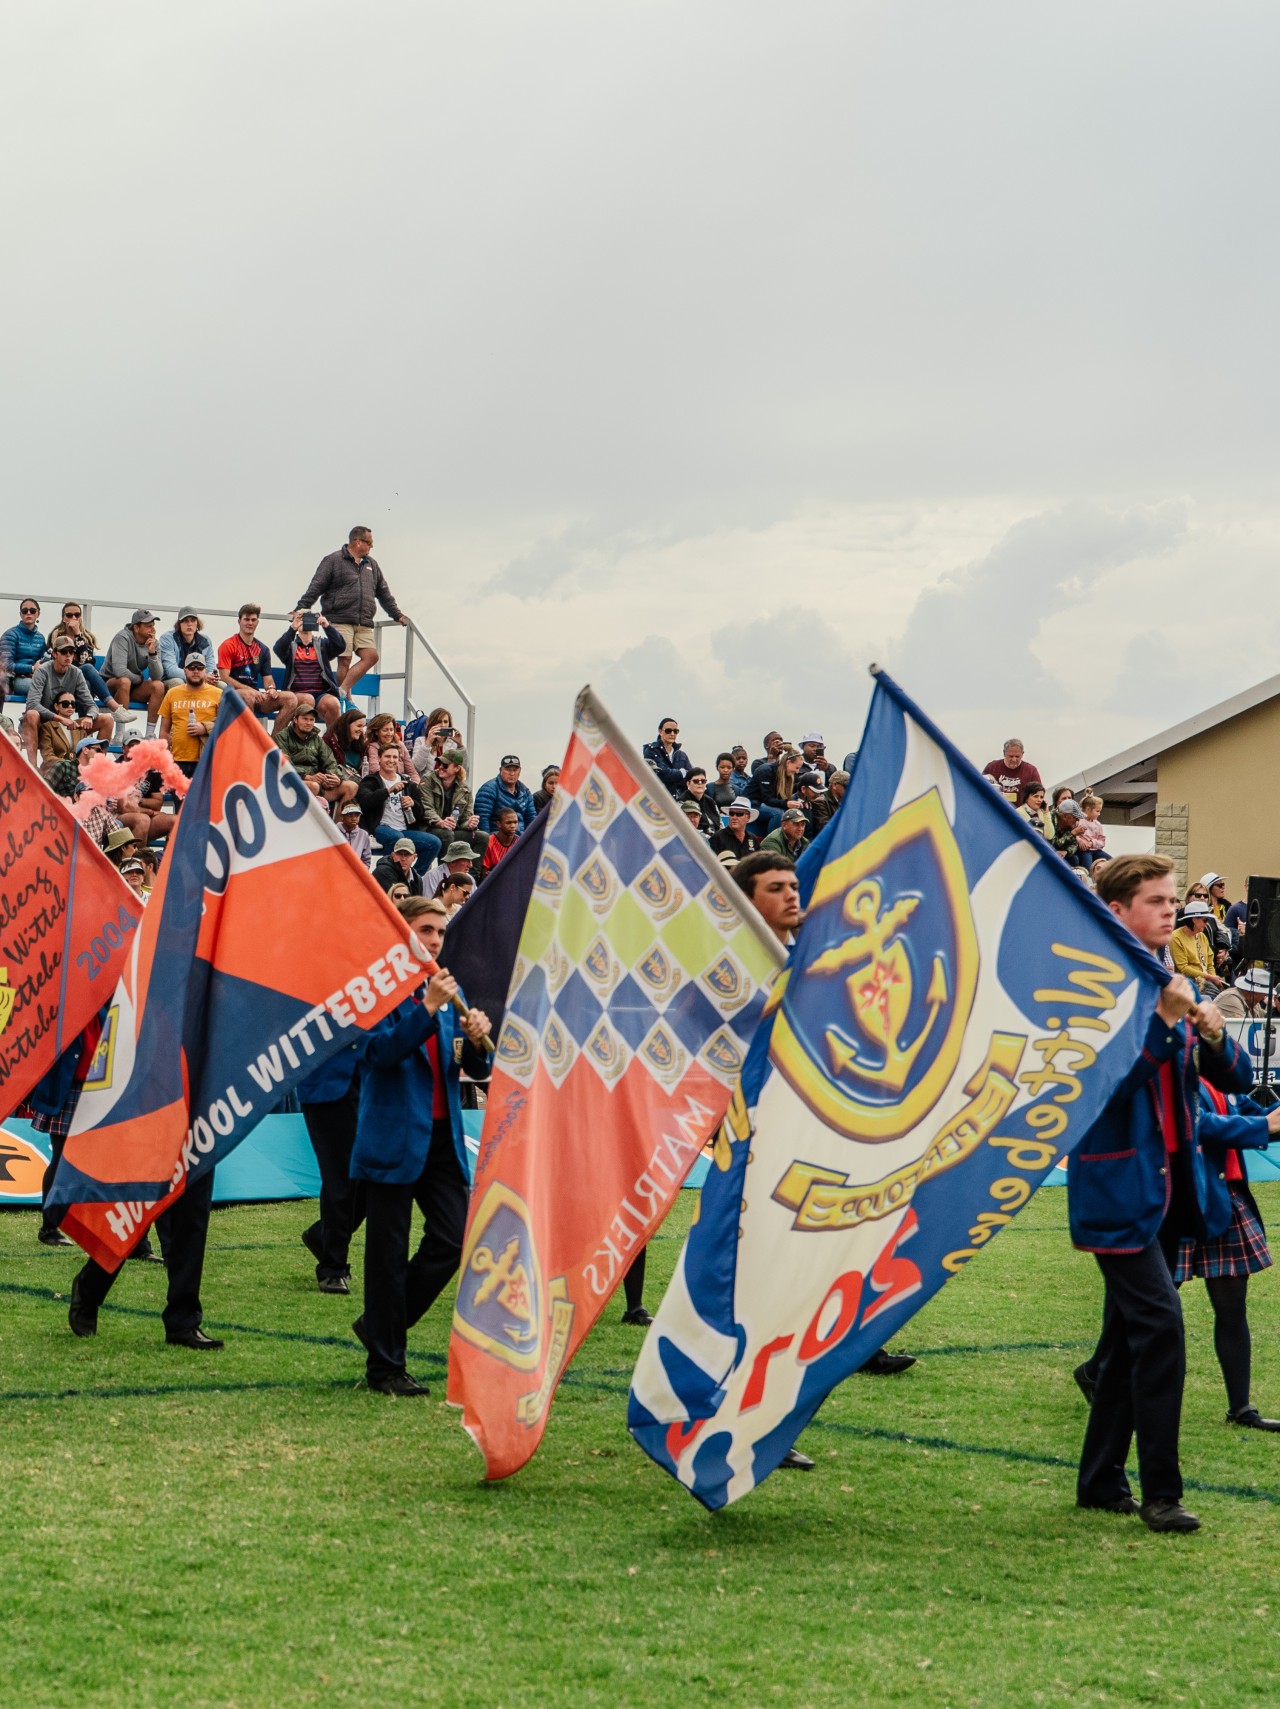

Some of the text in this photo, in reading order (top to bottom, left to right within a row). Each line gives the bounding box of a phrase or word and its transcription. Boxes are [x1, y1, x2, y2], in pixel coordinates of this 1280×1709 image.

[204, 748, 310, 895] 006
[77, 904, 138, 981] 2004
[105, 1086, 253, 1242] HOSKOOL
